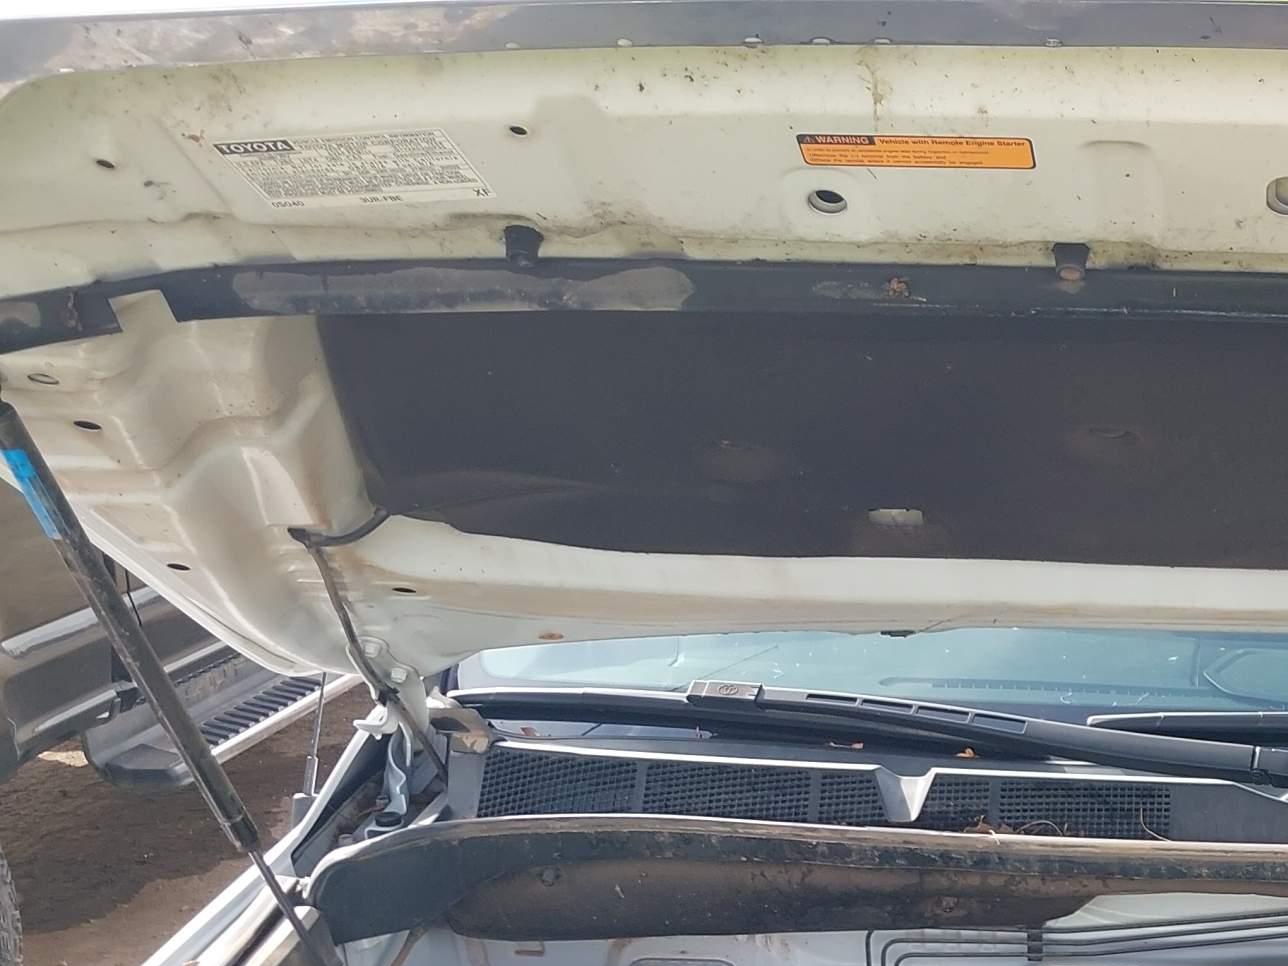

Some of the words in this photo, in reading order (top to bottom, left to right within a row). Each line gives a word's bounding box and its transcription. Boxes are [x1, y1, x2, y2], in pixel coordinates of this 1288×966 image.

[220, 140, 290, 154] TOYOTA
[814, 135, 870, 145] WARNING
[879, 138, 910, 146] Vehicle
[911, 138, 931, 146] with
[931, 139, 964, 147] Remote
[965, 139, 996, 148] Engine
